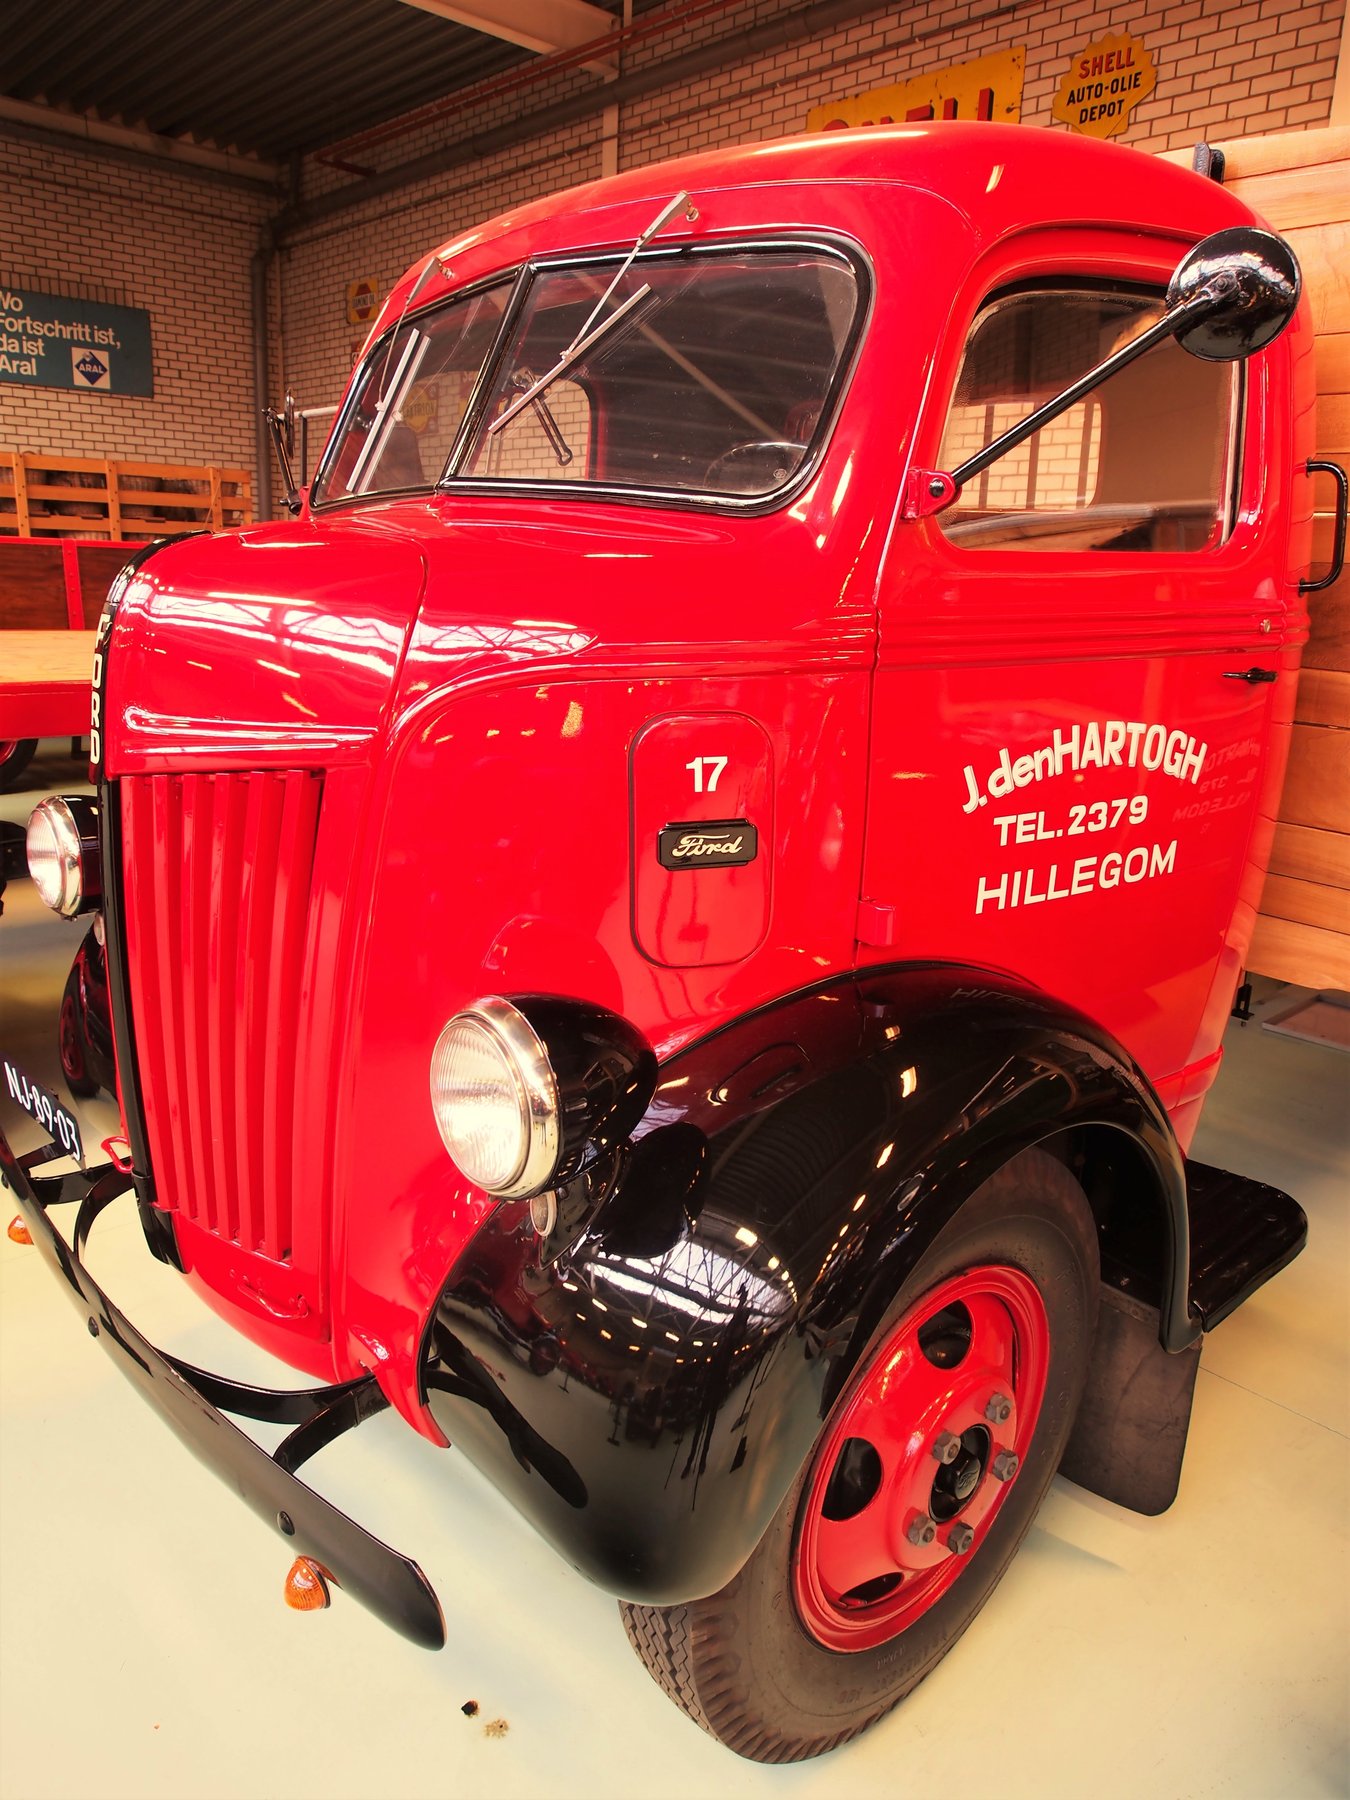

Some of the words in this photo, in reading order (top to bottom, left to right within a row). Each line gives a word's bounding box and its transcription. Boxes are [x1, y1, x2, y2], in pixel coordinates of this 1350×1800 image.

[1078, 46, 1136, 79] SHELL
[1066, 71, 1142, 106] AUTO-OLIE
[1079, 99, 1125, 125] DEPOT
[22, 336, 45, 357] ist
[93, 325, 121, 349] ist,
[0, 354, 37, 376] Aral
[78, 363, 104, 374] ARAL
[90, 613, 112, 765] FORD
[685, 756, 728, 793] 17
[1067, 795, 1149, 836] 2379
[671, 834, 743, 858] Ford
[975, 839, 1178, 915] HILLEGOM
